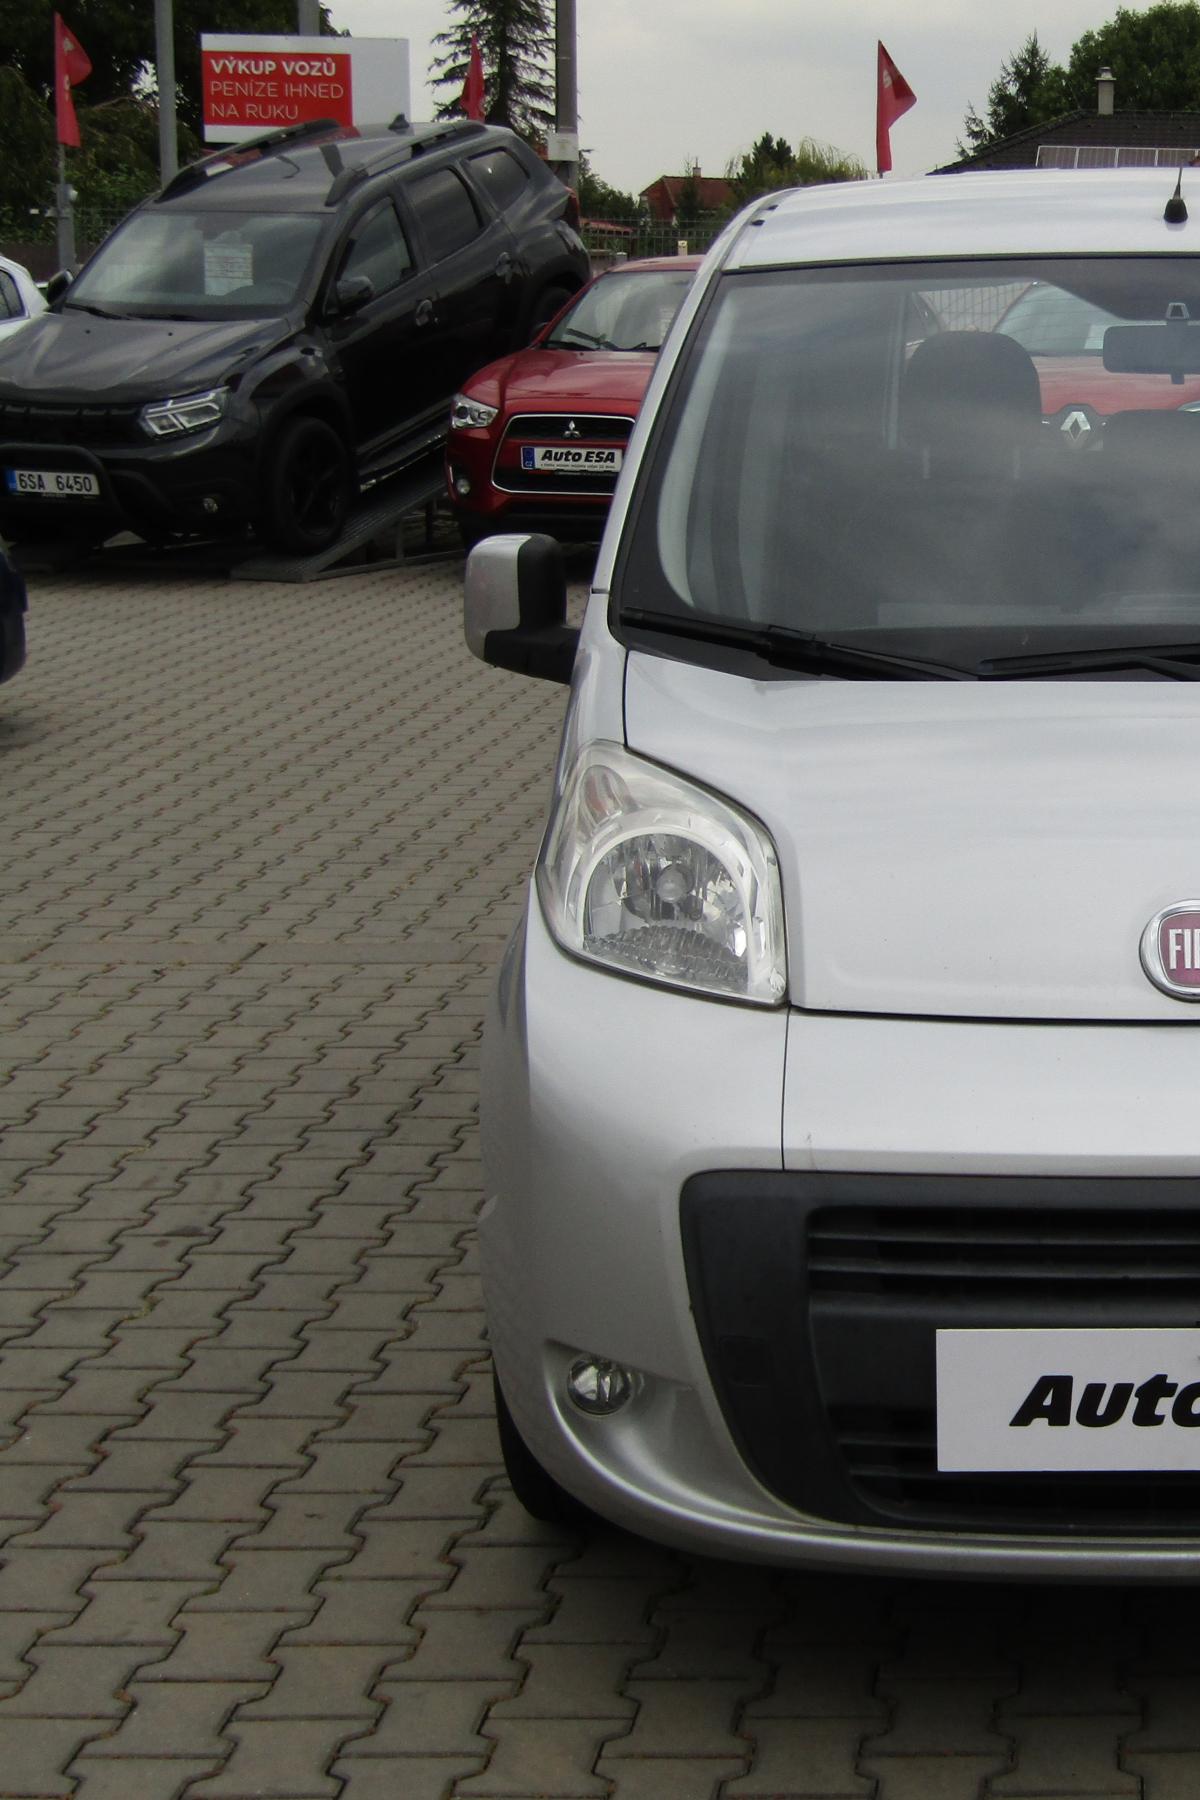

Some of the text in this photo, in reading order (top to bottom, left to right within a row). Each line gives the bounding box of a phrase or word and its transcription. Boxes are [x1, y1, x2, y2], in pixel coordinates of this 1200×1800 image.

[210, 57, 336, 76] VÝKUP VOZŮ
[210, 79, 344, 99] PENÍZE IHNED
[211, 103, 299, 119] NA RUKU
[541, 449, 616, 463] Auto ESA
[18, 473, 93, 493] 6SA 6450
